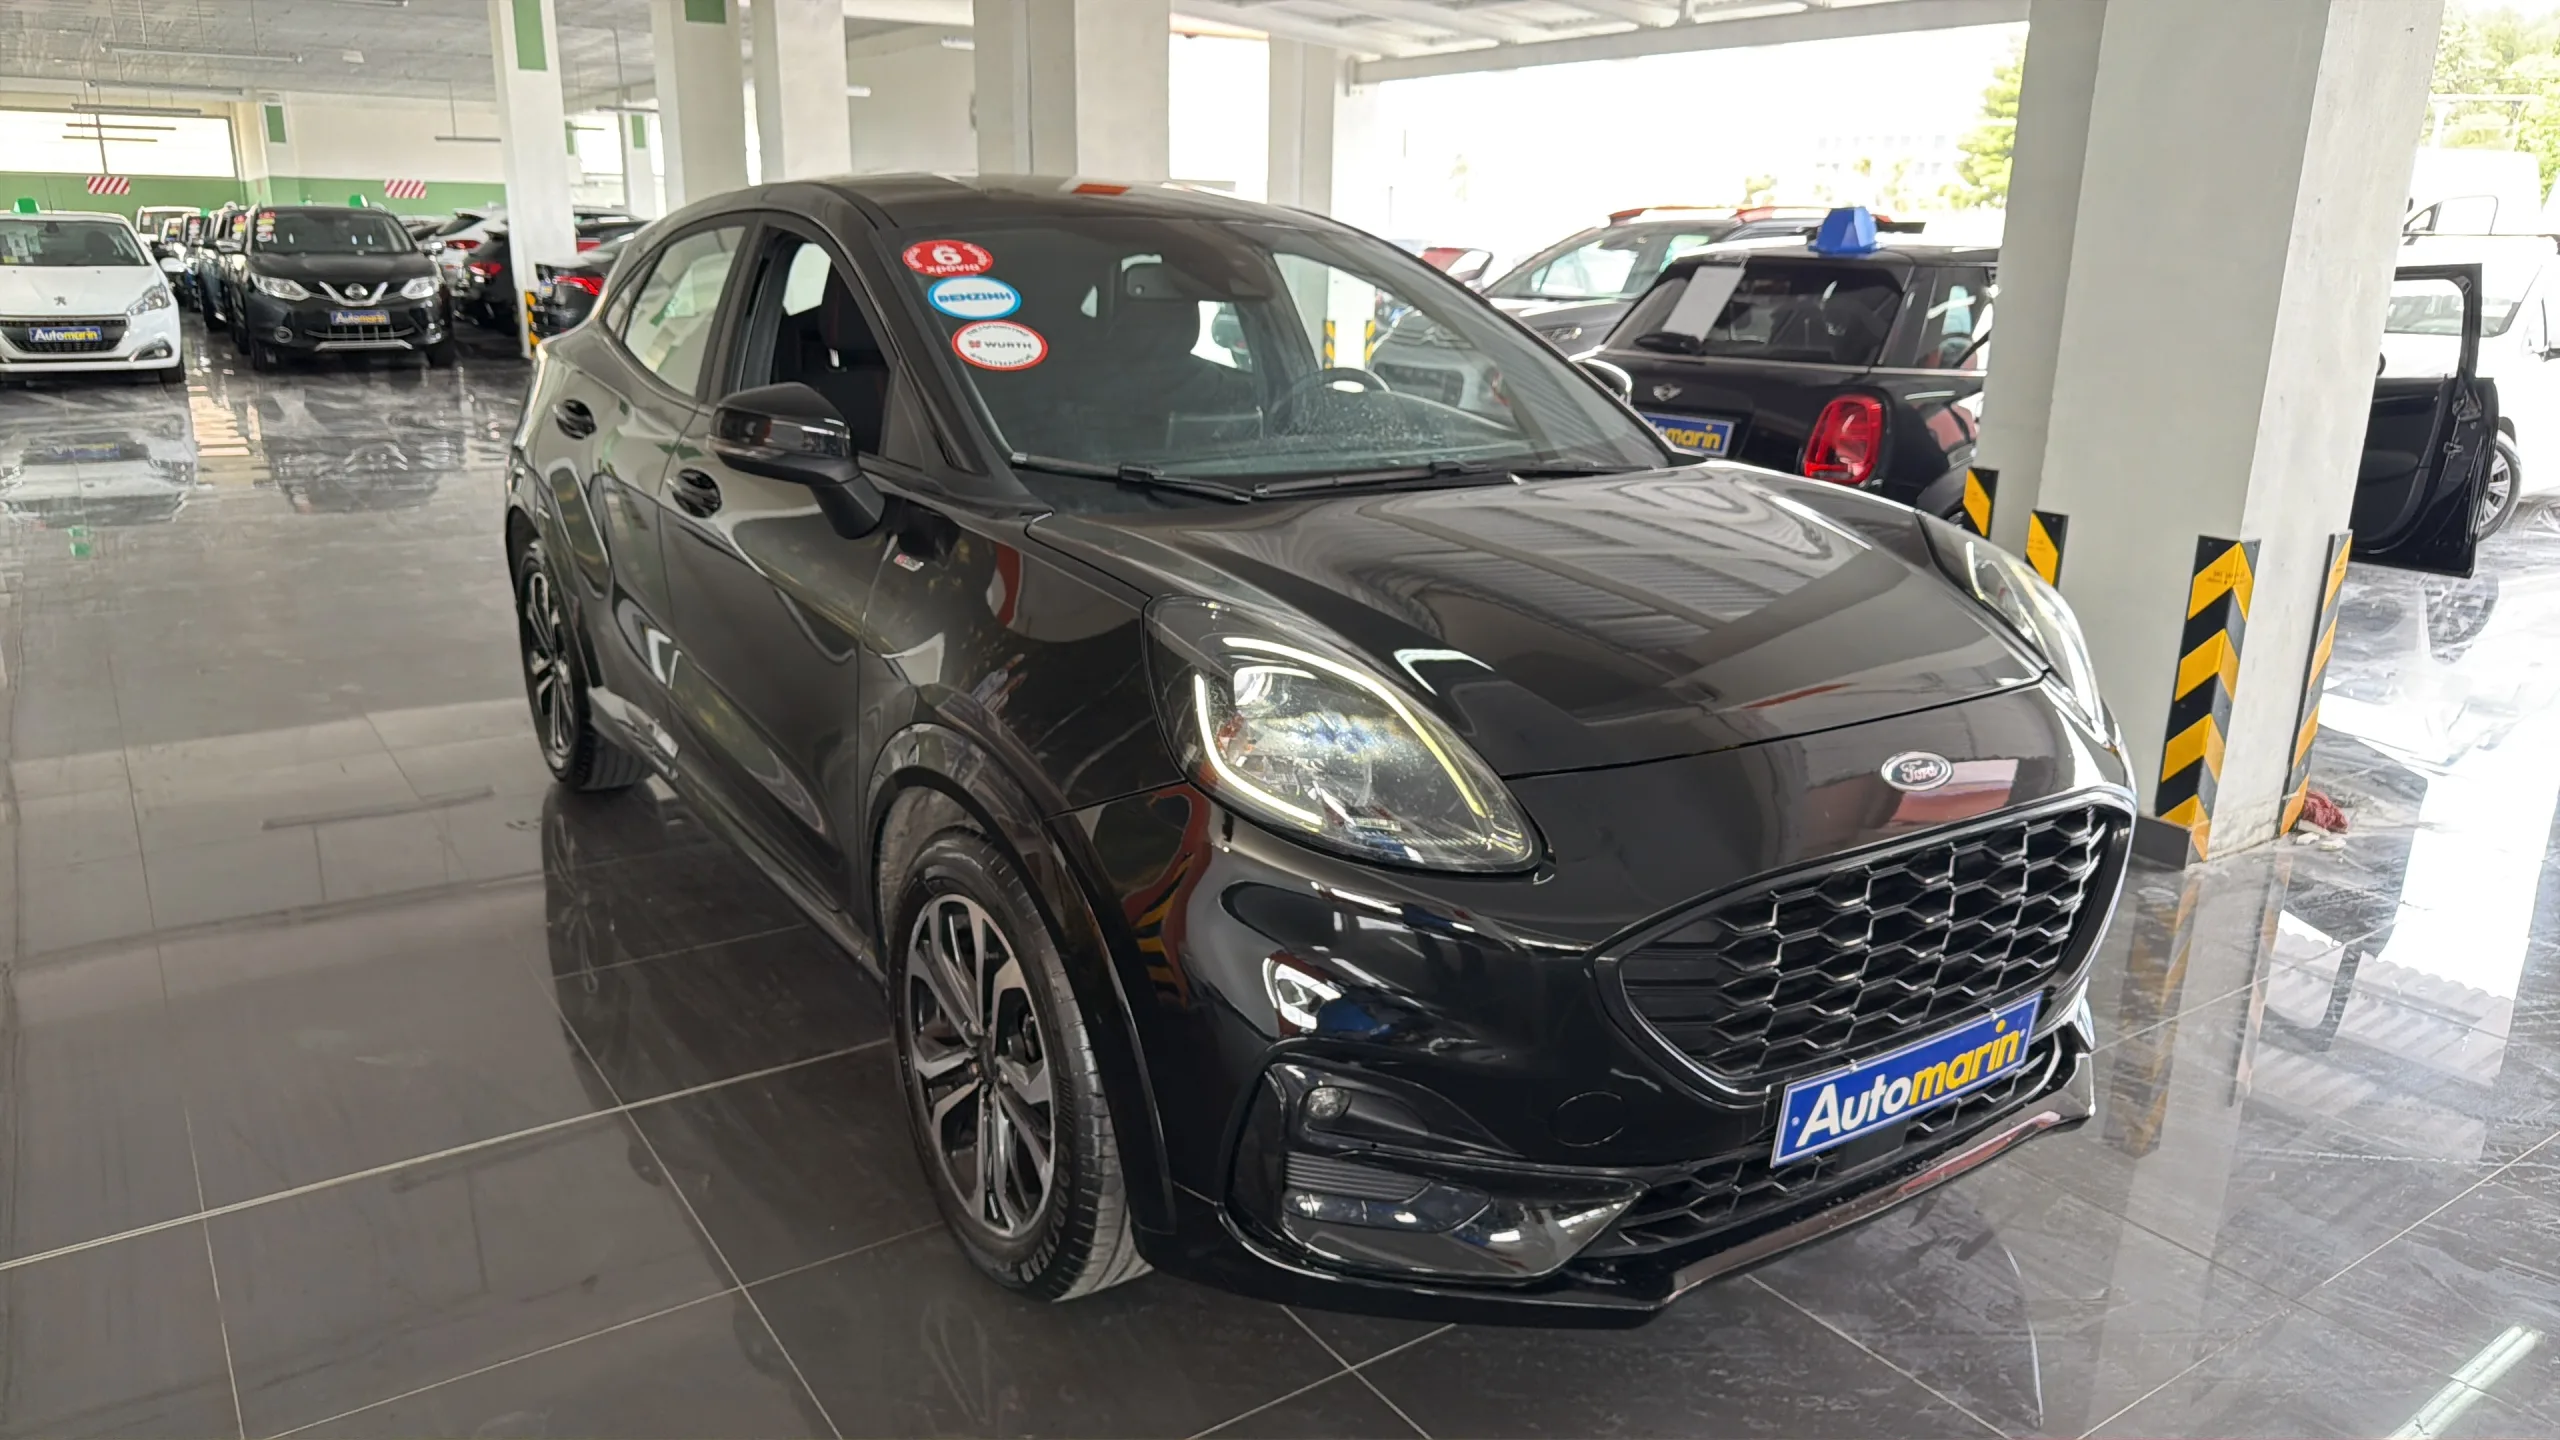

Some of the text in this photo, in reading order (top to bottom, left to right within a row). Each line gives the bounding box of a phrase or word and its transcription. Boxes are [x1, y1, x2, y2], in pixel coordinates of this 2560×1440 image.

[932, 245, 962, 265] 6
[35, 328, 97, 341] Automarin
[1900, 760, 1939, 782] Ford
[1795, 1019, 2022, 1148] Automarin
